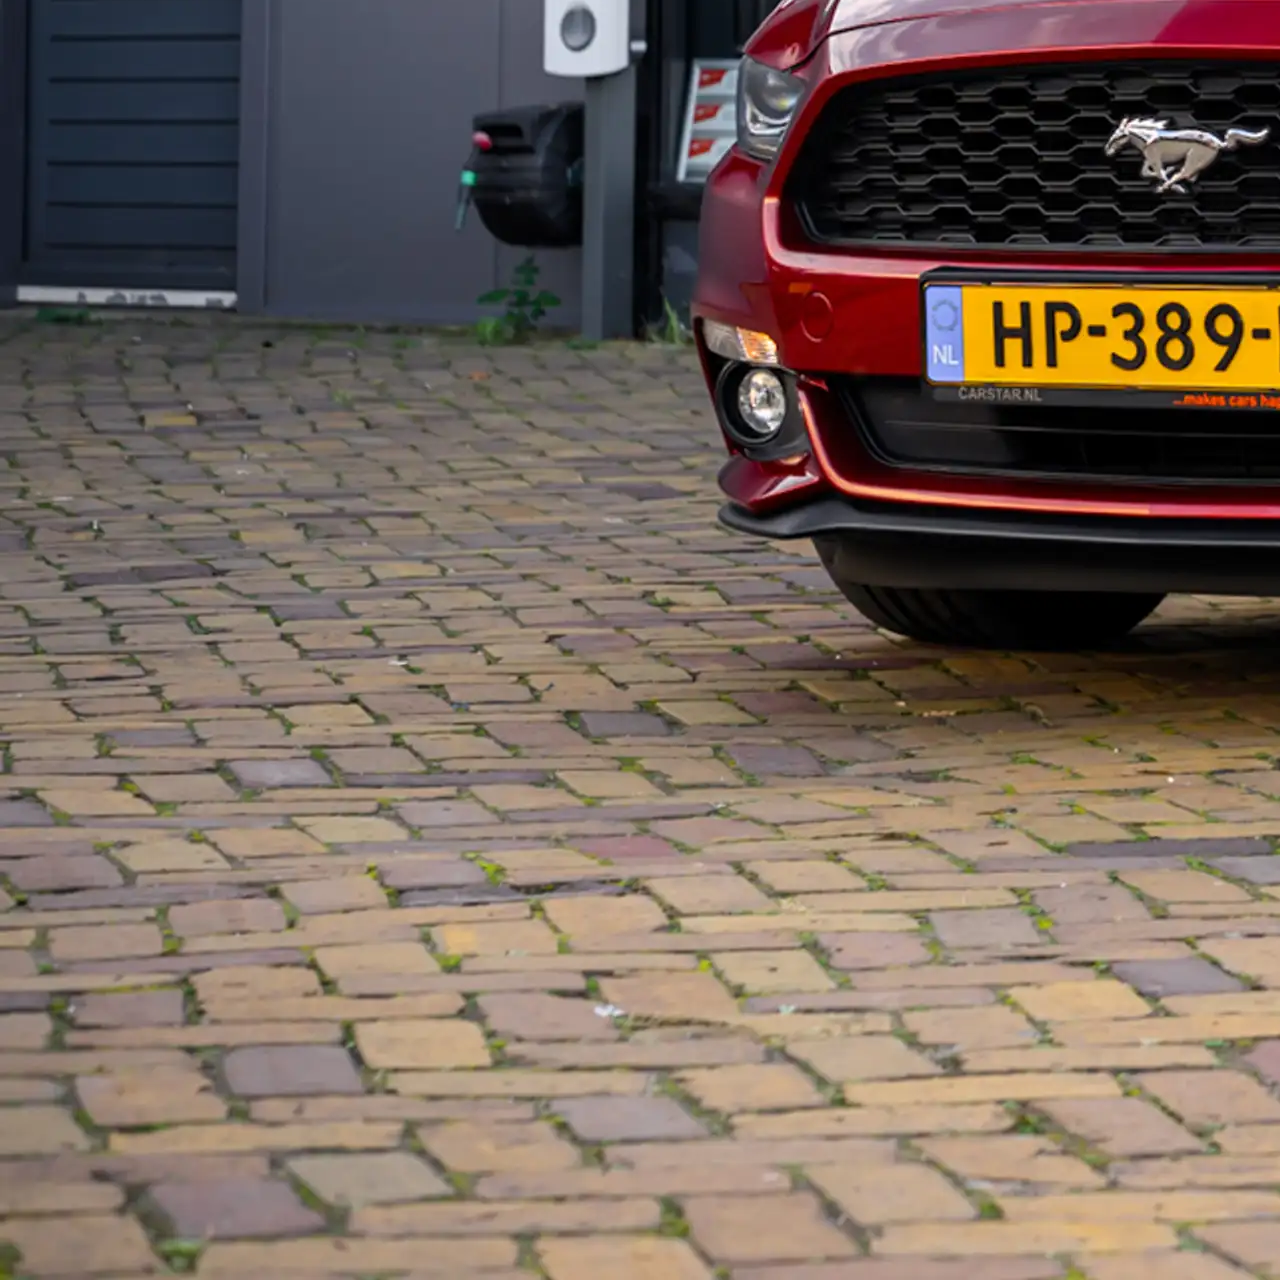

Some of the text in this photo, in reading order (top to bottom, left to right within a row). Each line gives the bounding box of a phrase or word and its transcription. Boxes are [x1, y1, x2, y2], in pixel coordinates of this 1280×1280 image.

[932, 344, 959, 367] NL
[958, 386, 1043, 402] CARSTAR.NL
[1229, 396, 1257, 408] cars
